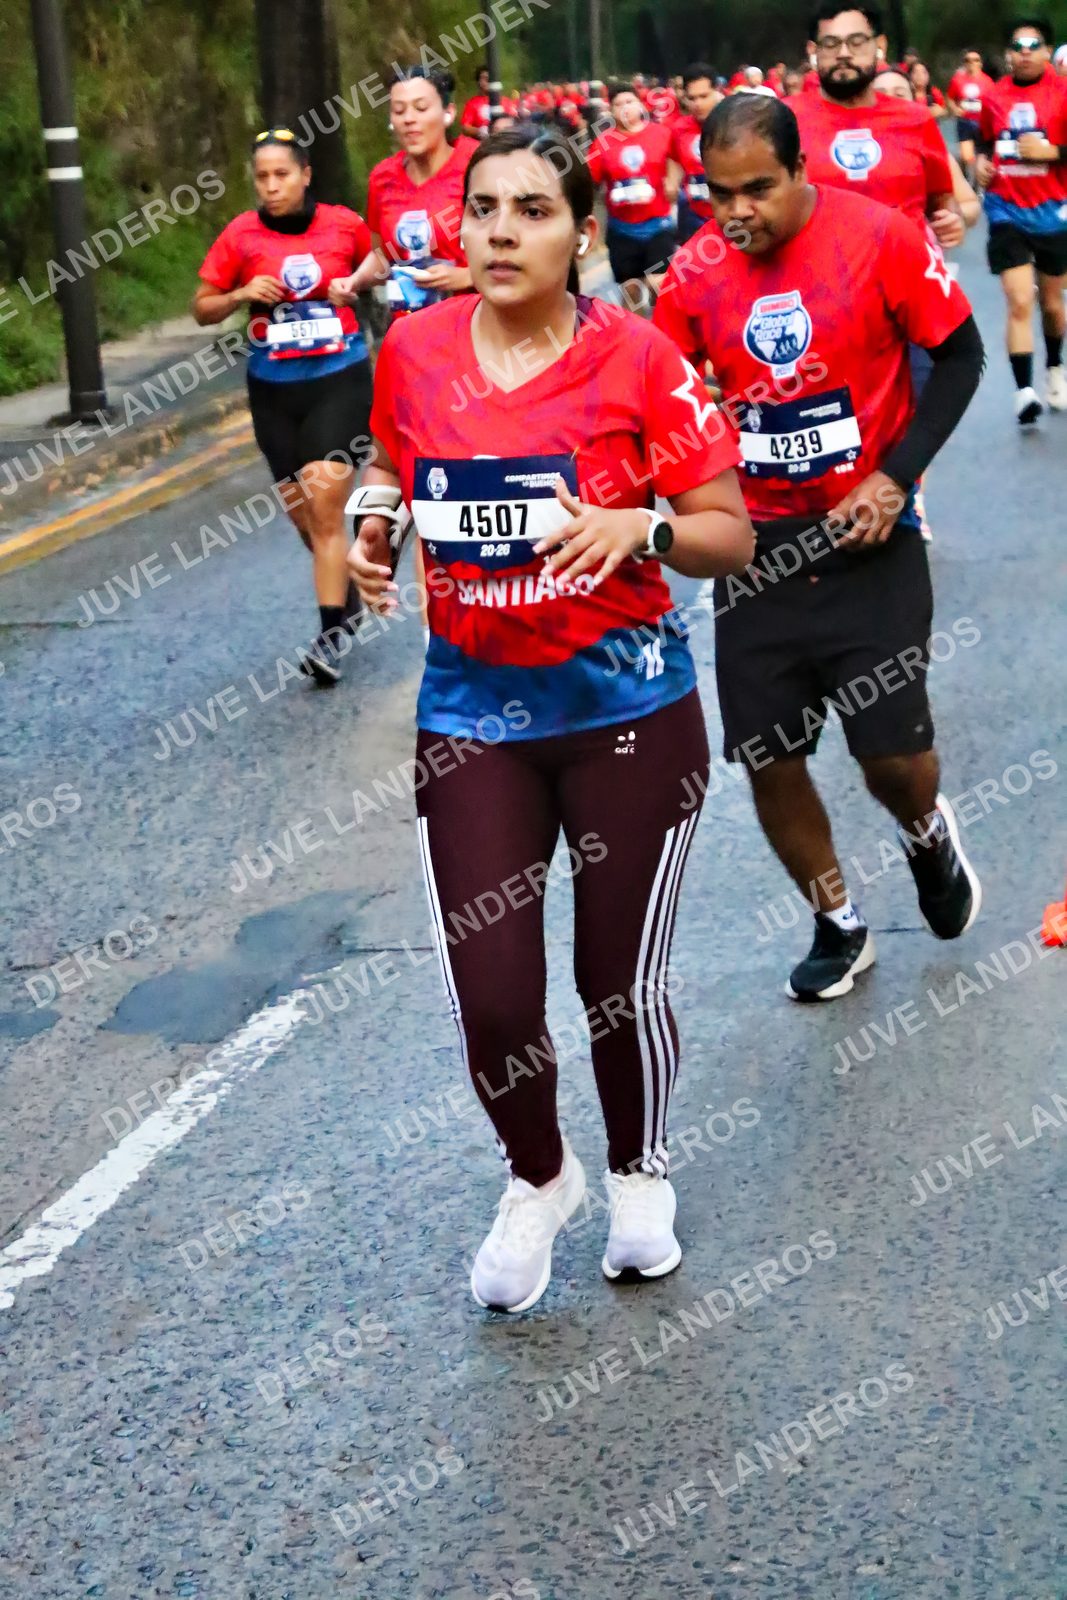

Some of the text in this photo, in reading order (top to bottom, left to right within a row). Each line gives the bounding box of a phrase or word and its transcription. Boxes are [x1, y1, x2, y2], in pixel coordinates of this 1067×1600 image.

[769, 429, 823, 460] 4239
[459, 503, 529, 537] 4507
[480, 543, 511, 557] 20-26
[457, 573, 594, 608] SANTIAGO
